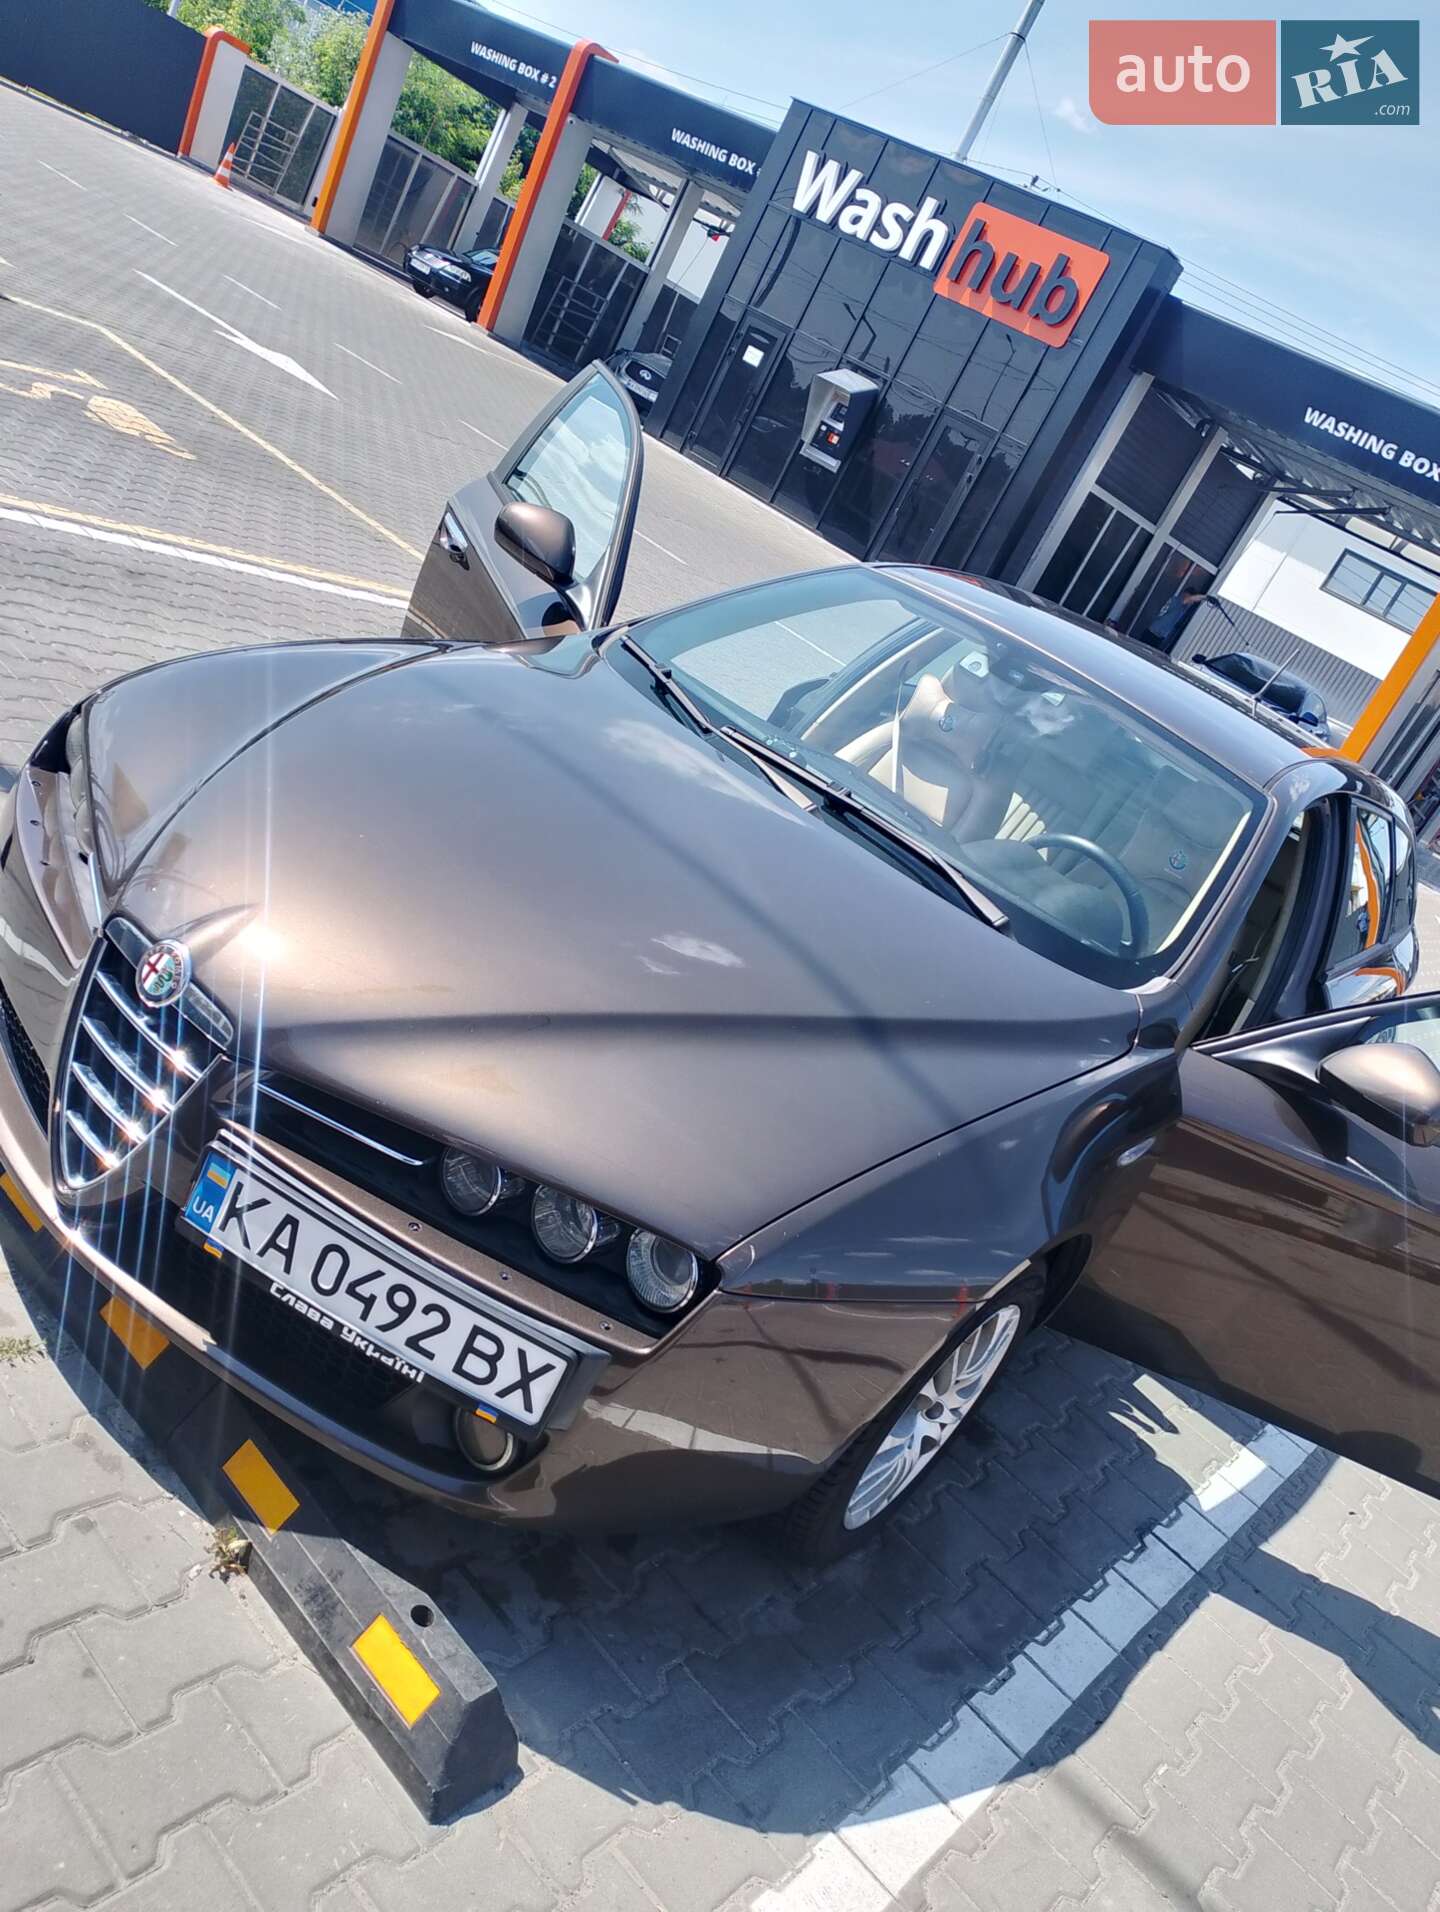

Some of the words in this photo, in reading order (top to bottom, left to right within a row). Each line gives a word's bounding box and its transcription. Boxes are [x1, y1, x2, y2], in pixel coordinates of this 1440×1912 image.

[471, 41, 518, 71] WASHING
[517, 61, 541, 82] BOX
[548, 75, 557, 88] 2
[671, 128, 728, 162] WASHING
[728, 153, 756, 175] BOX
[792, 150, 949, 271] Wash
[947, 218, 1080, 326] hub
[1304, 406, 1398, 460] WASHING
[1398, 450, 1440, 482] BOX
[193, 1196, 214, 1223] UA
[218, 1180, 302, 1275] KA
[310, 1244, 452, 1361] 0492
[451, 1324, 557, 1413] BX
[269, 1282, 335, 1330] Слава
